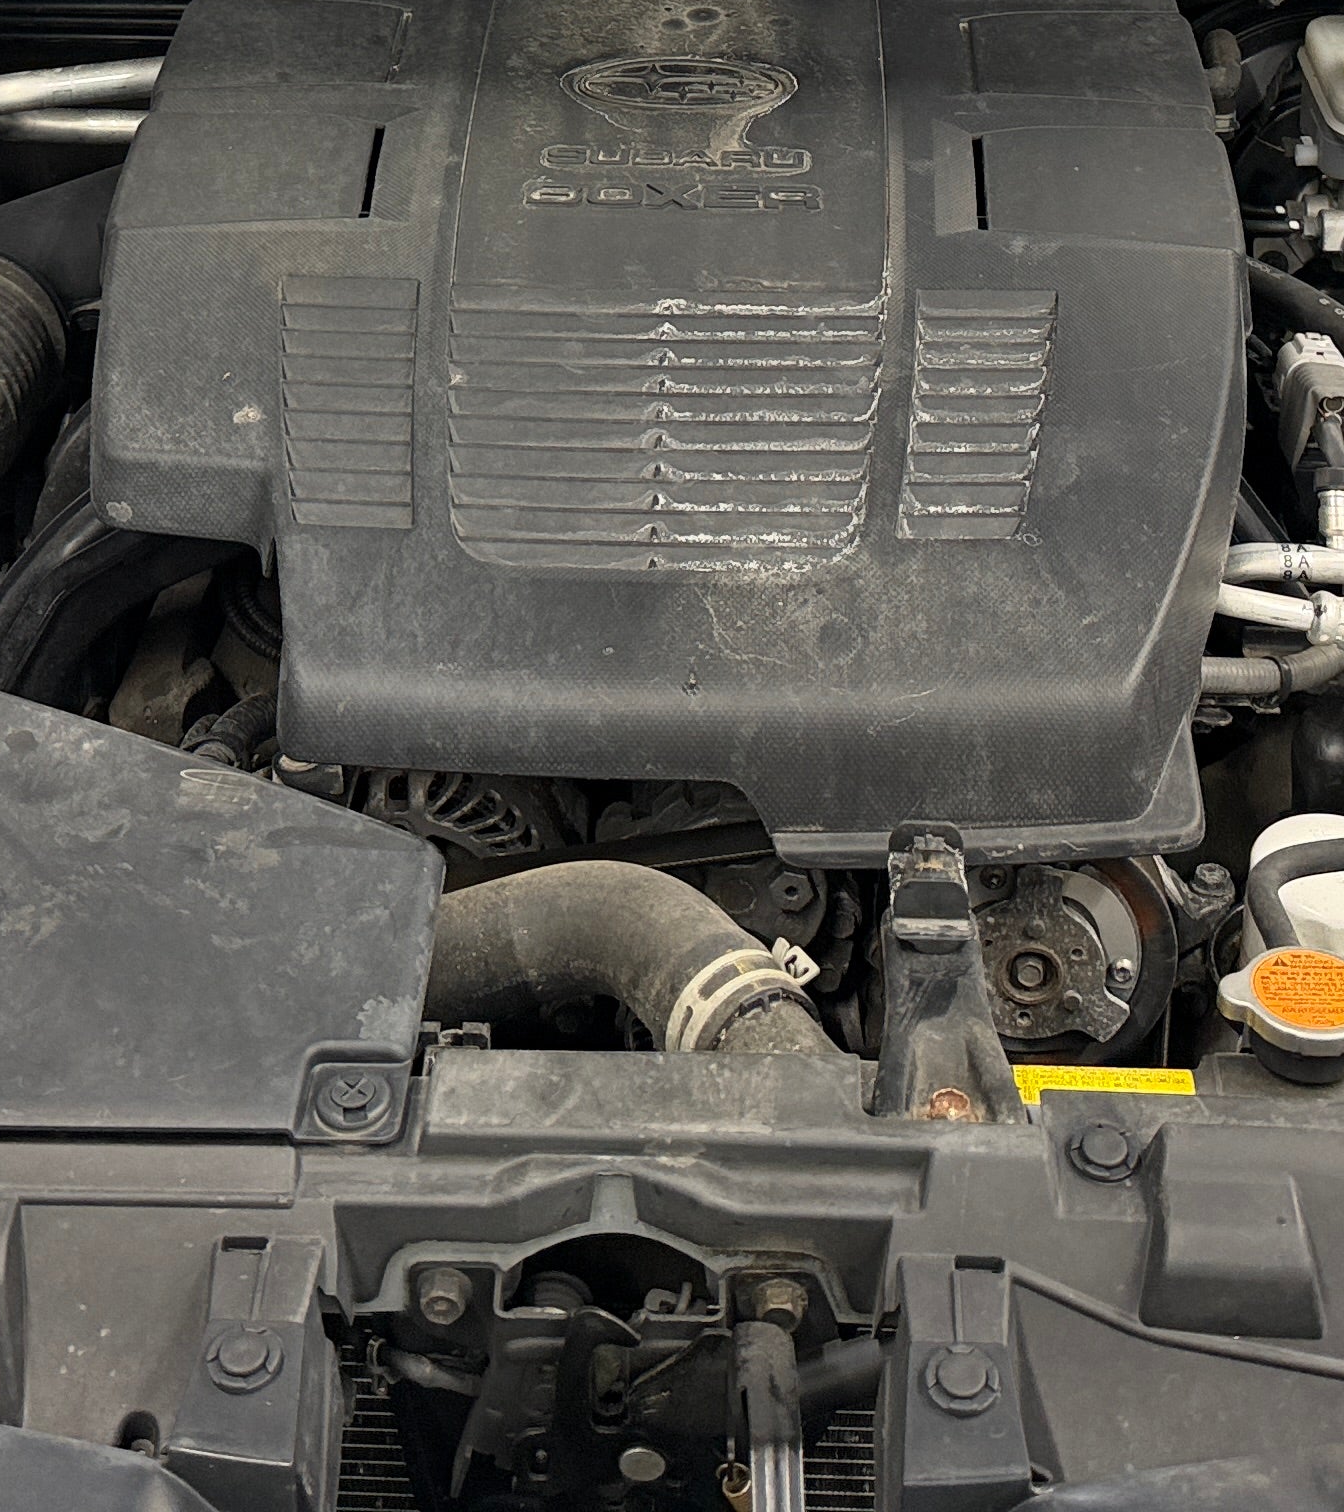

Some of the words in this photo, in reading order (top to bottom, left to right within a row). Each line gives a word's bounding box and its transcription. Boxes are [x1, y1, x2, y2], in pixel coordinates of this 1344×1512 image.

[541, 144, 806, 170] SUBARU
[524, 183, 824, 211] BOXER
[1283, 554, 1293, 568] 8
[1298, 554, 1310, 569] A
